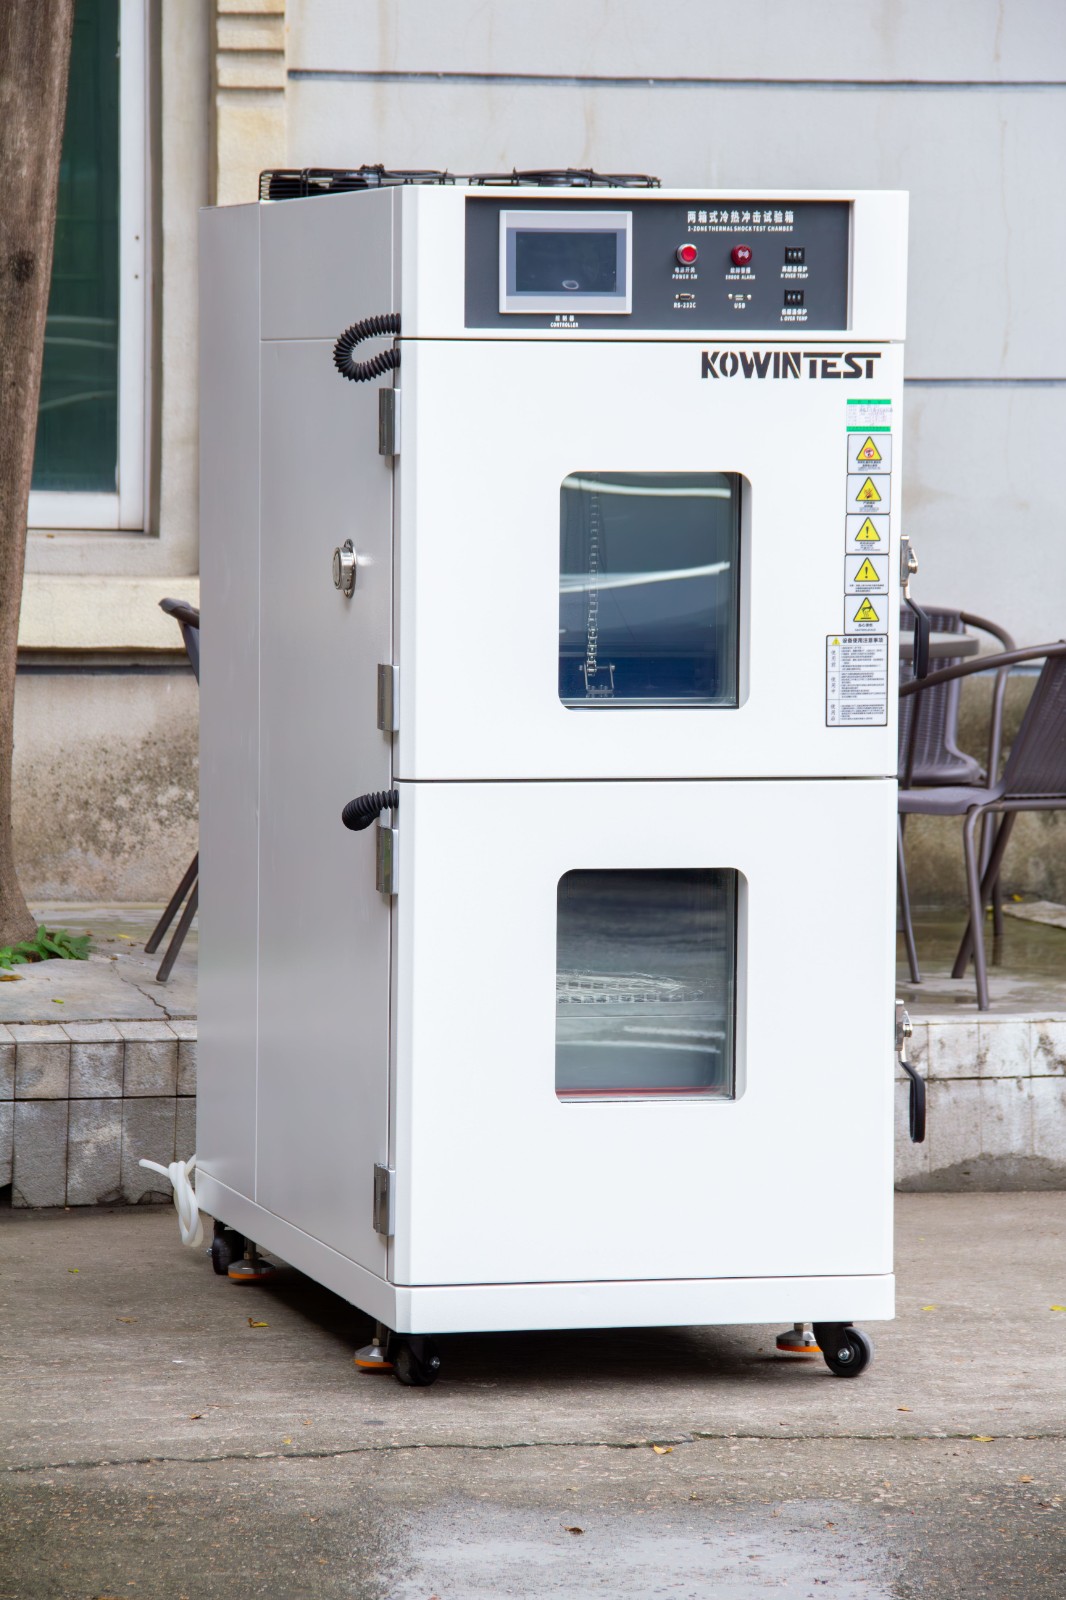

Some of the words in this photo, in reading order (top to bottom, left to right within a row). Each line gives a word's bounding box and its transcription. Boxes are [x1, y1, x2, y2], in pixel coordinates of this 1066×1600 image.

[687, 211, 794, 223] 两箱式冷热冲击试验箱
[701, 351, 882, 379] KOWINTEST
